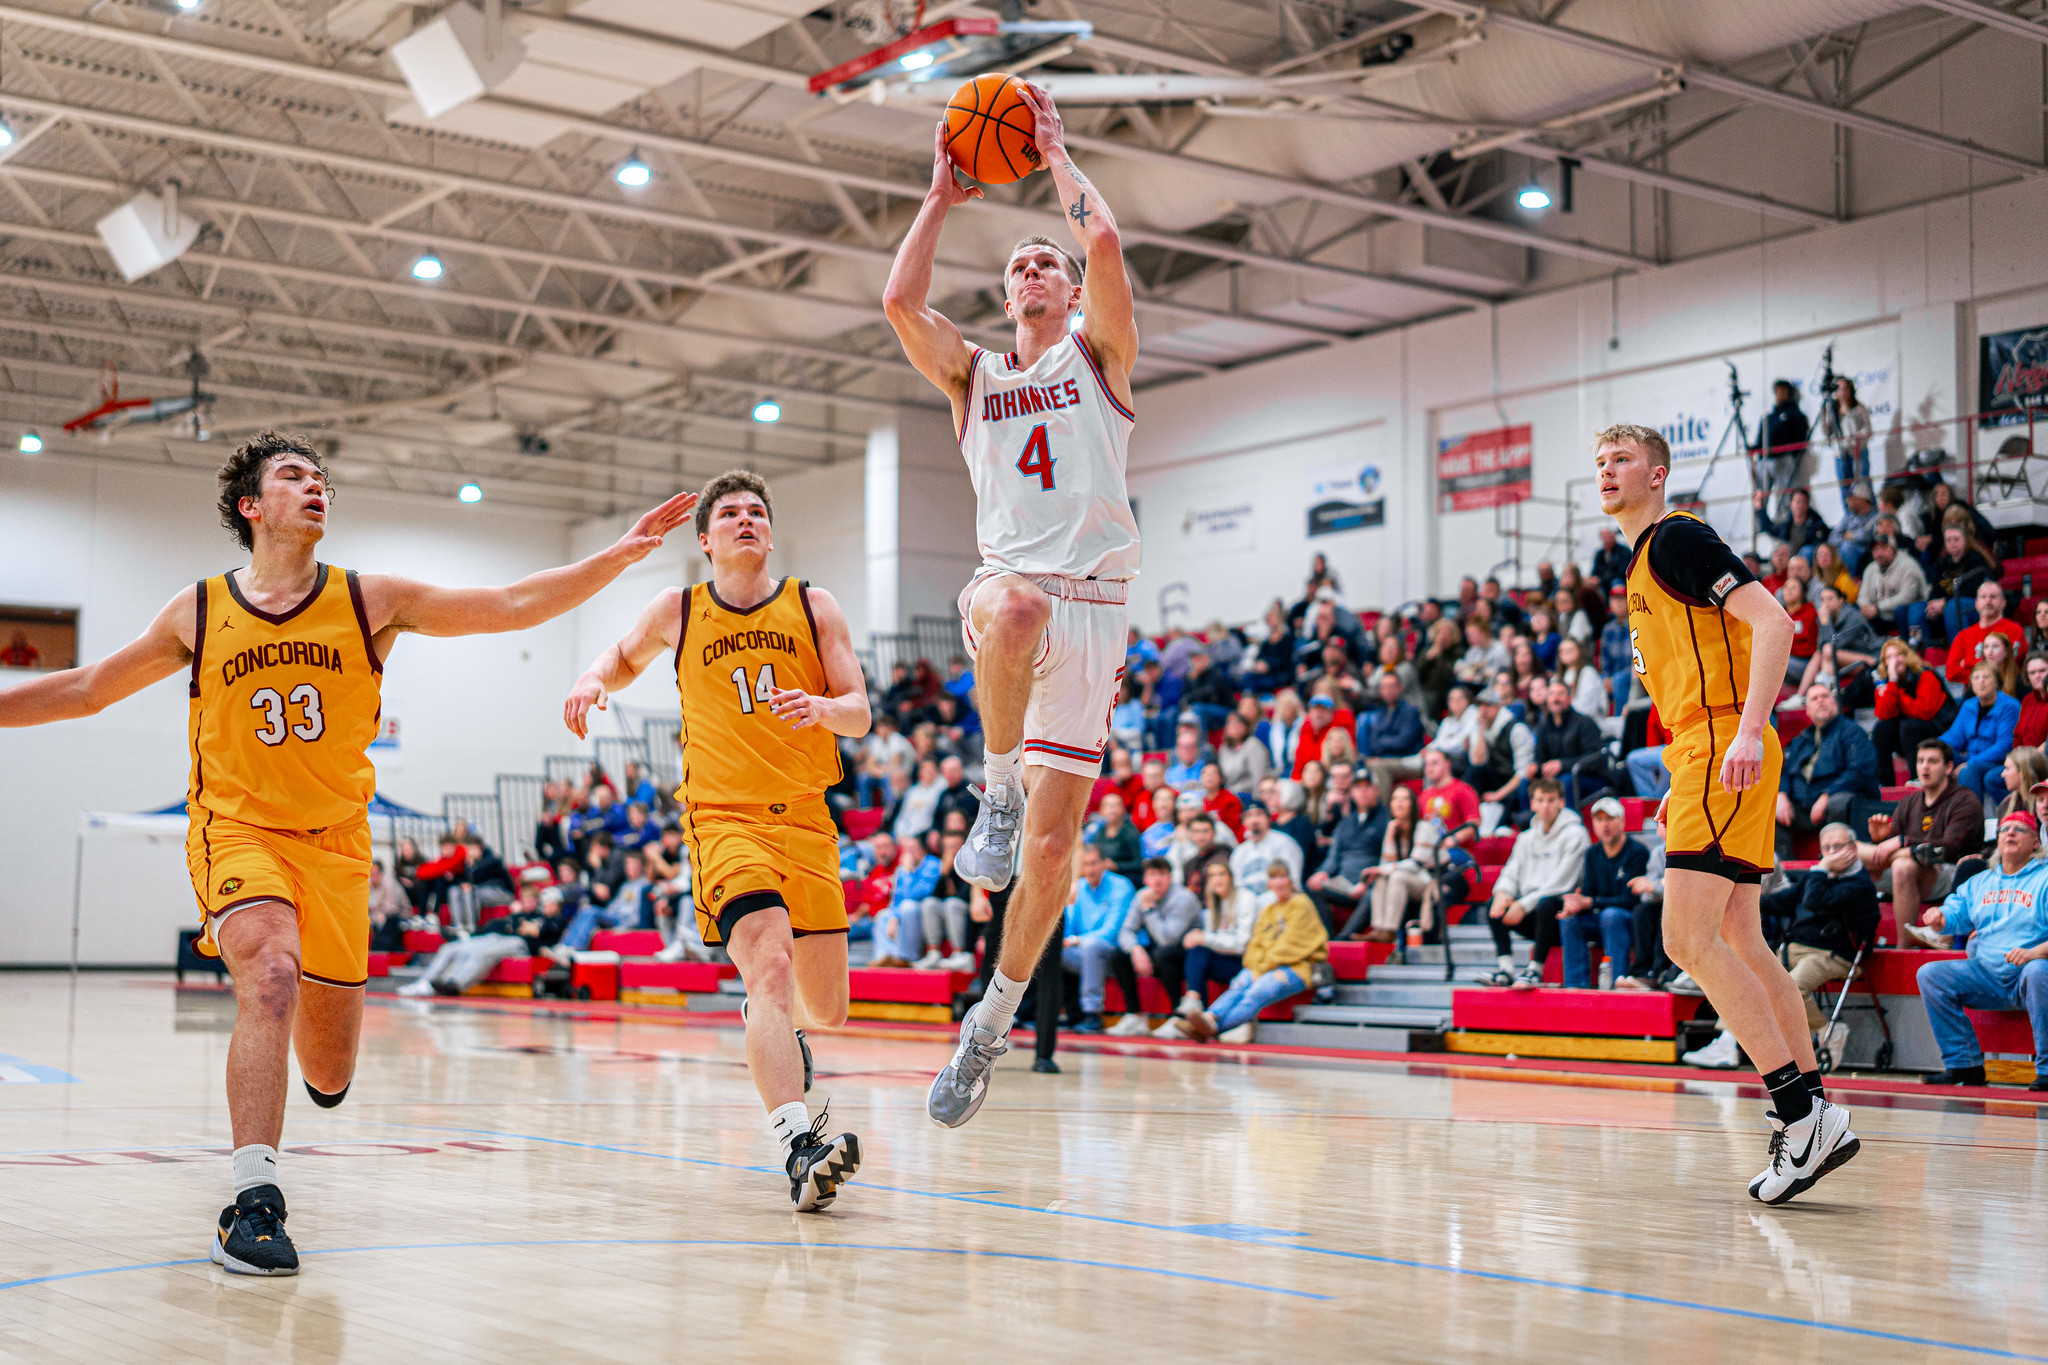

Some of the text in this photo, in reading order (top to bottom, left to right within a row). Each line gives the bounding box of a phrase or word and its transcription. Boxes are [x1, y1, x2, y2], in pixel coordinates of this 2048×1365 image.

[982, 378, 1081, 422] JOHNNIES
[1015, 422, 1058, 492] 4
[222, 641, 343, 687] CONCORDIA
[702, 629, 798, 667] CONCORDIA
[730, 663, 783, 715] 14
[250, 683, 326, 748] 33
